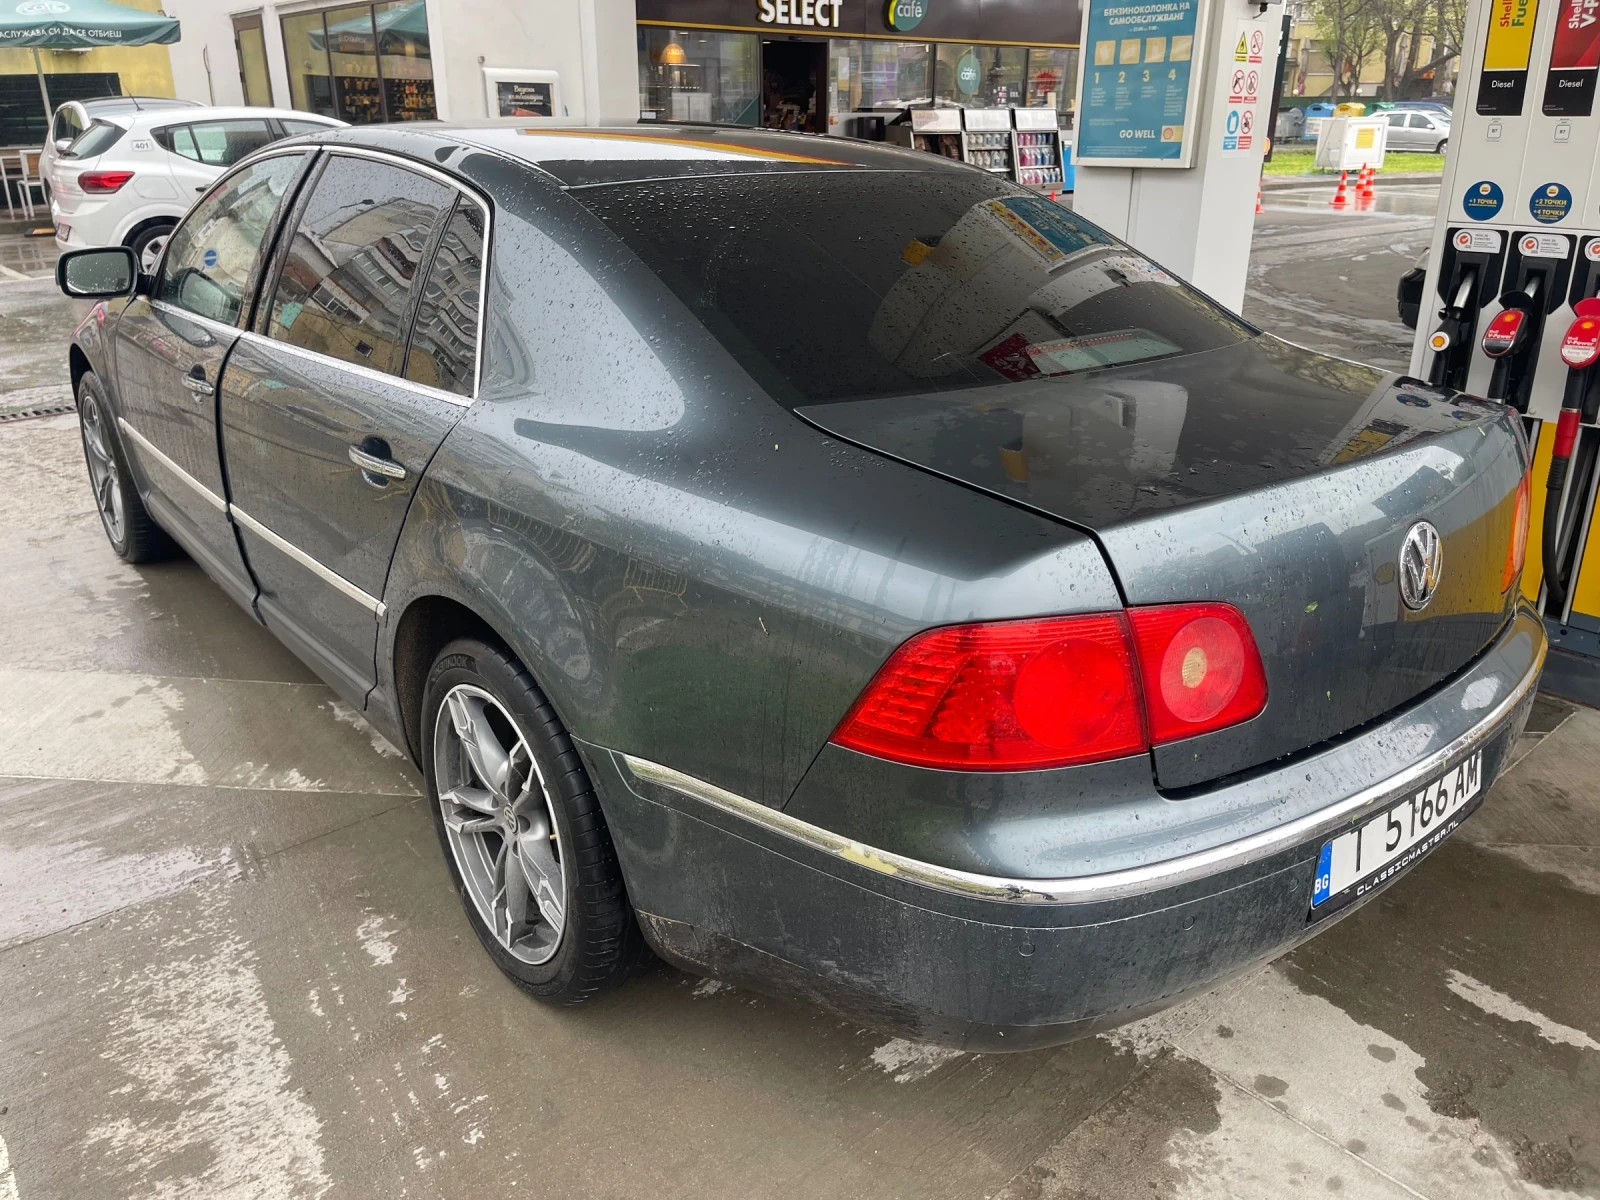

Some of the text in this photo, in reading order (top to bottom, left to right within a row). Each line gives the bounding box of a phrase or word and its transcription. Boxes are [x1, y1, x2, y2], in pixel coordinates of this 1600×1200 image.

[759, 0, 843, 28] SELECT
[896, 0, 923, 18] café
[1104, 2, 1190, 17] БЕНЗИНОКОЛОНКА НА
[1500, 0, 1512, 27] Shell
[1568, 0, 1583, 29] Shell
[1109, 12, 1185, 25] САМООБСЛУЖВАНЕ
[48, 28, 60, 36] СИ
[62, 28, 76, 36] ДА
[76, 29, 87, 37] СЕ
[88, 29, 122, 38] ОТБИЕШ
[960, 67, 976, 80] café
[1094, 72, 1100, 84] 1
[1118, 71, 1126, 83] 2
[1142, 69, 1150, 82] 3
[1168, 68, 1176, 81] 4
[1491, 79, 1515, 89] Diesel
[1558, 78, 1584, 89] Diesel
[1119, 129, 1156, 139] GO WELL
[1351, 754, 1479, 872] T 5166 AM
[1313, 874, 1329, 895] BG
